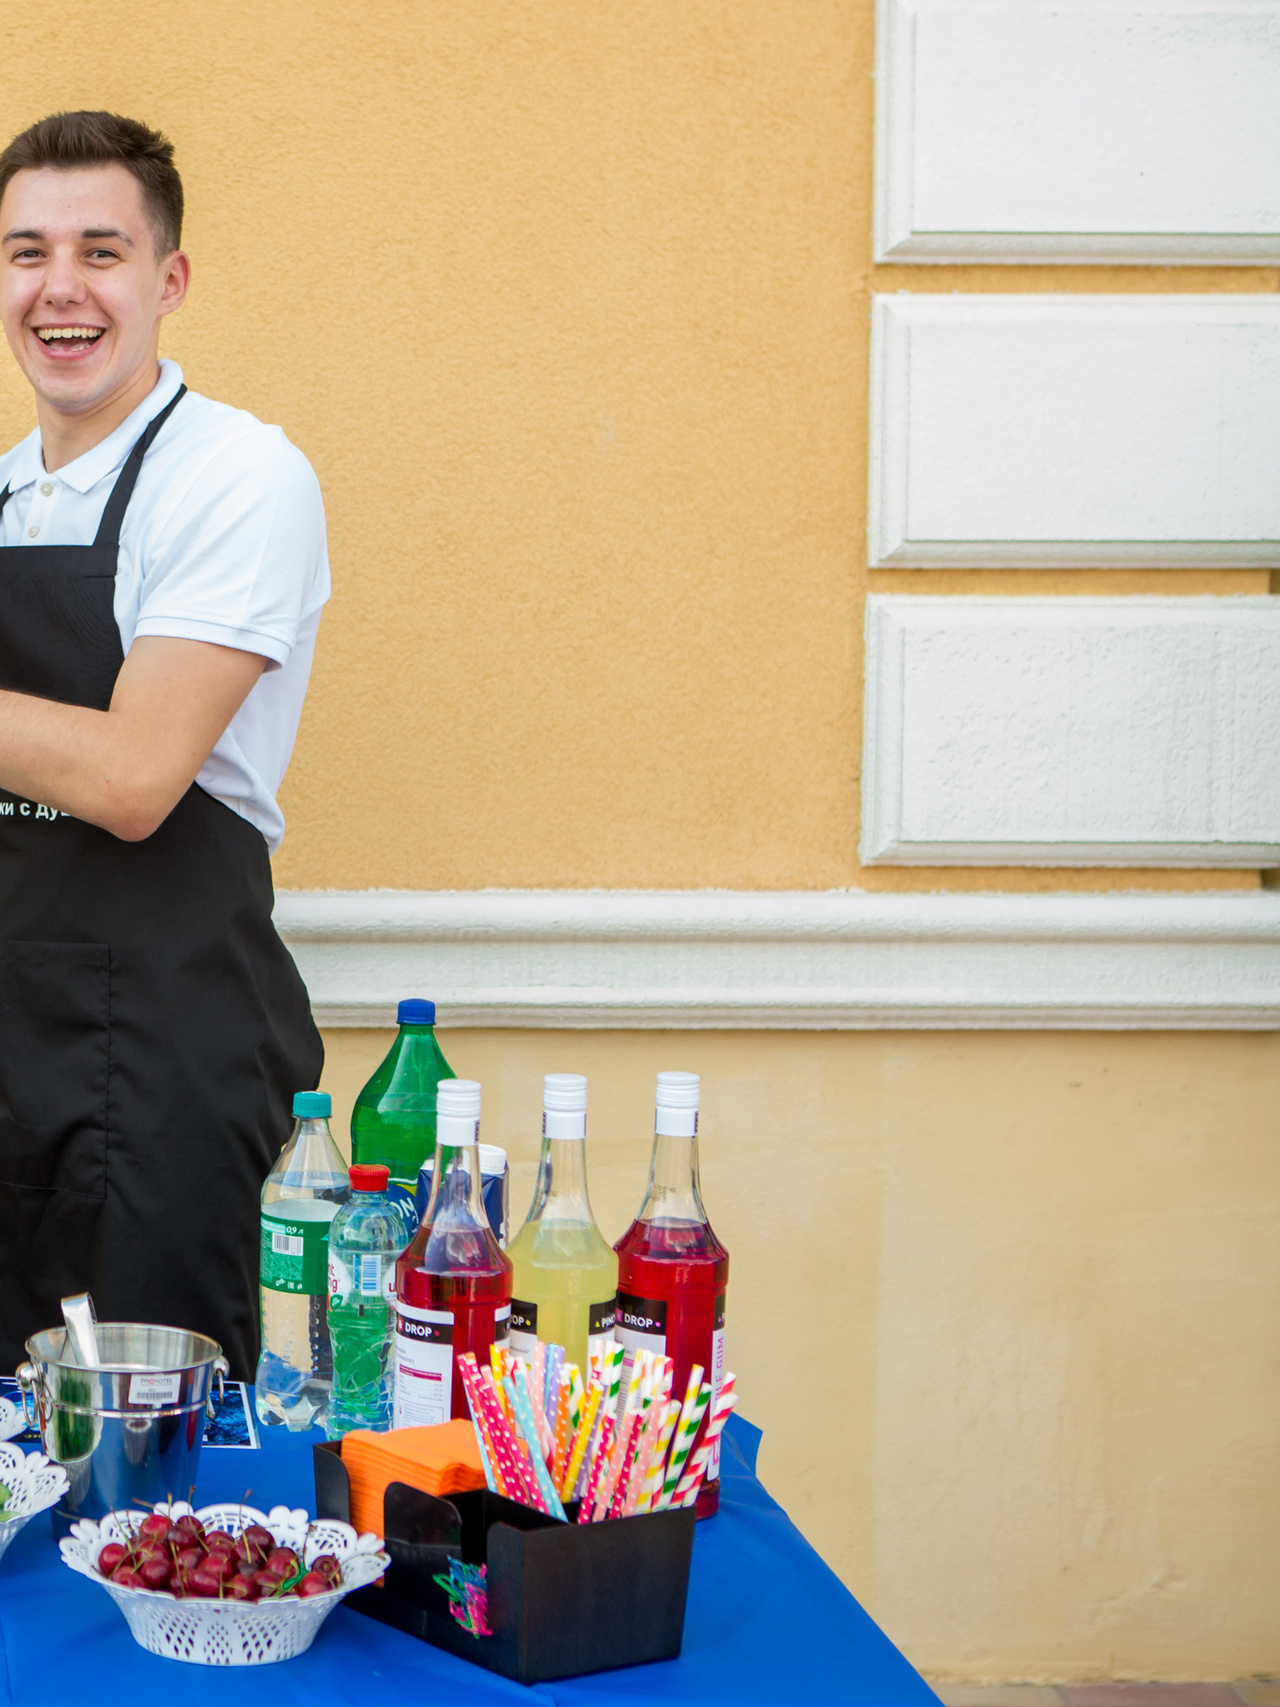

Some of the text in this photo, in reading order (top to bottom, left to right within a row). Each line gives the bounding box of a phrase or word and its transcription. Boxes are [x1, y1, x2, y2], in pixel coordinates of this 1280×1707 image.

[510, 1314, 525, 1326] OP
[624, 1312, 654, 1329] DROP
[404, 1321, 433, 1338] DROP
